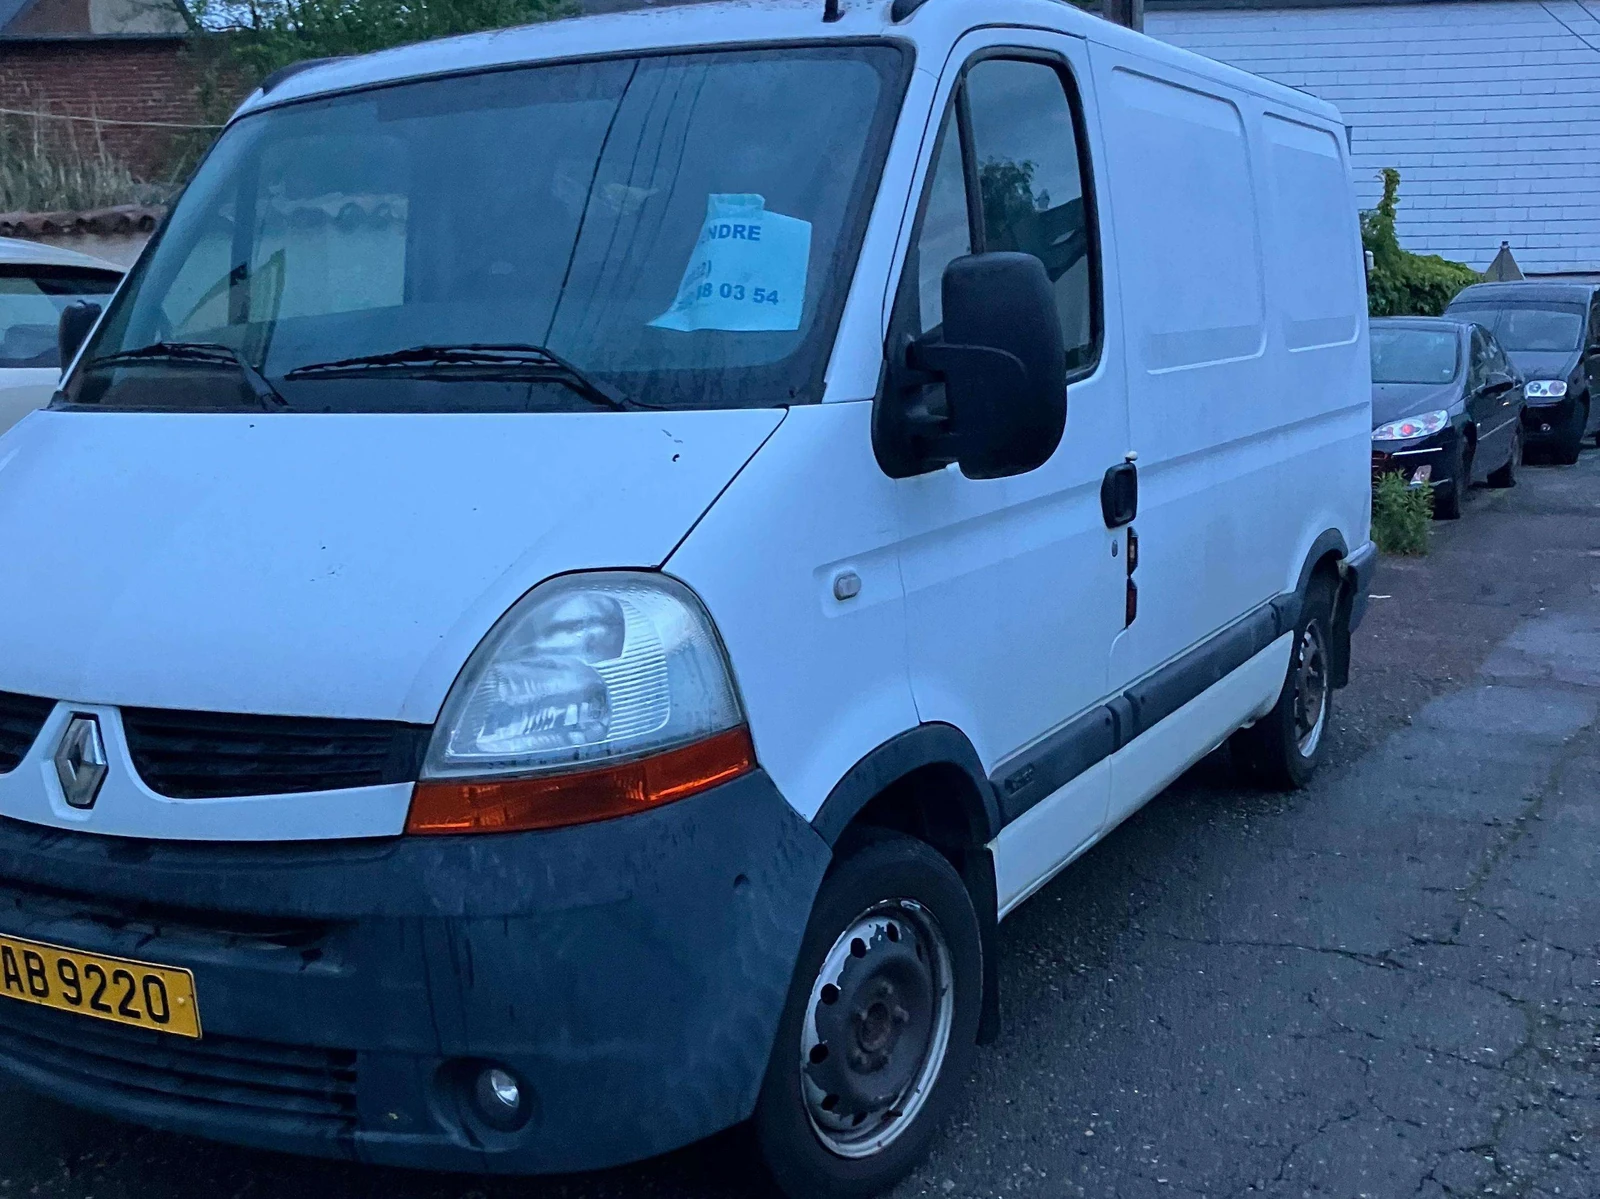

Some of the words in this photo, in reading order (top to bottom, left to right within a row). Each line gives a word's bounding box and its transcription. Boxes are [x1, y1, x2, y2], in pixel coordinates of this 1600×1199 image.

[719, 283, 746, 301] 03
[753, 287, 780, 306] 54
[1, 944, 49, 999] AB
[57, 957, 170, 1024] 9220
